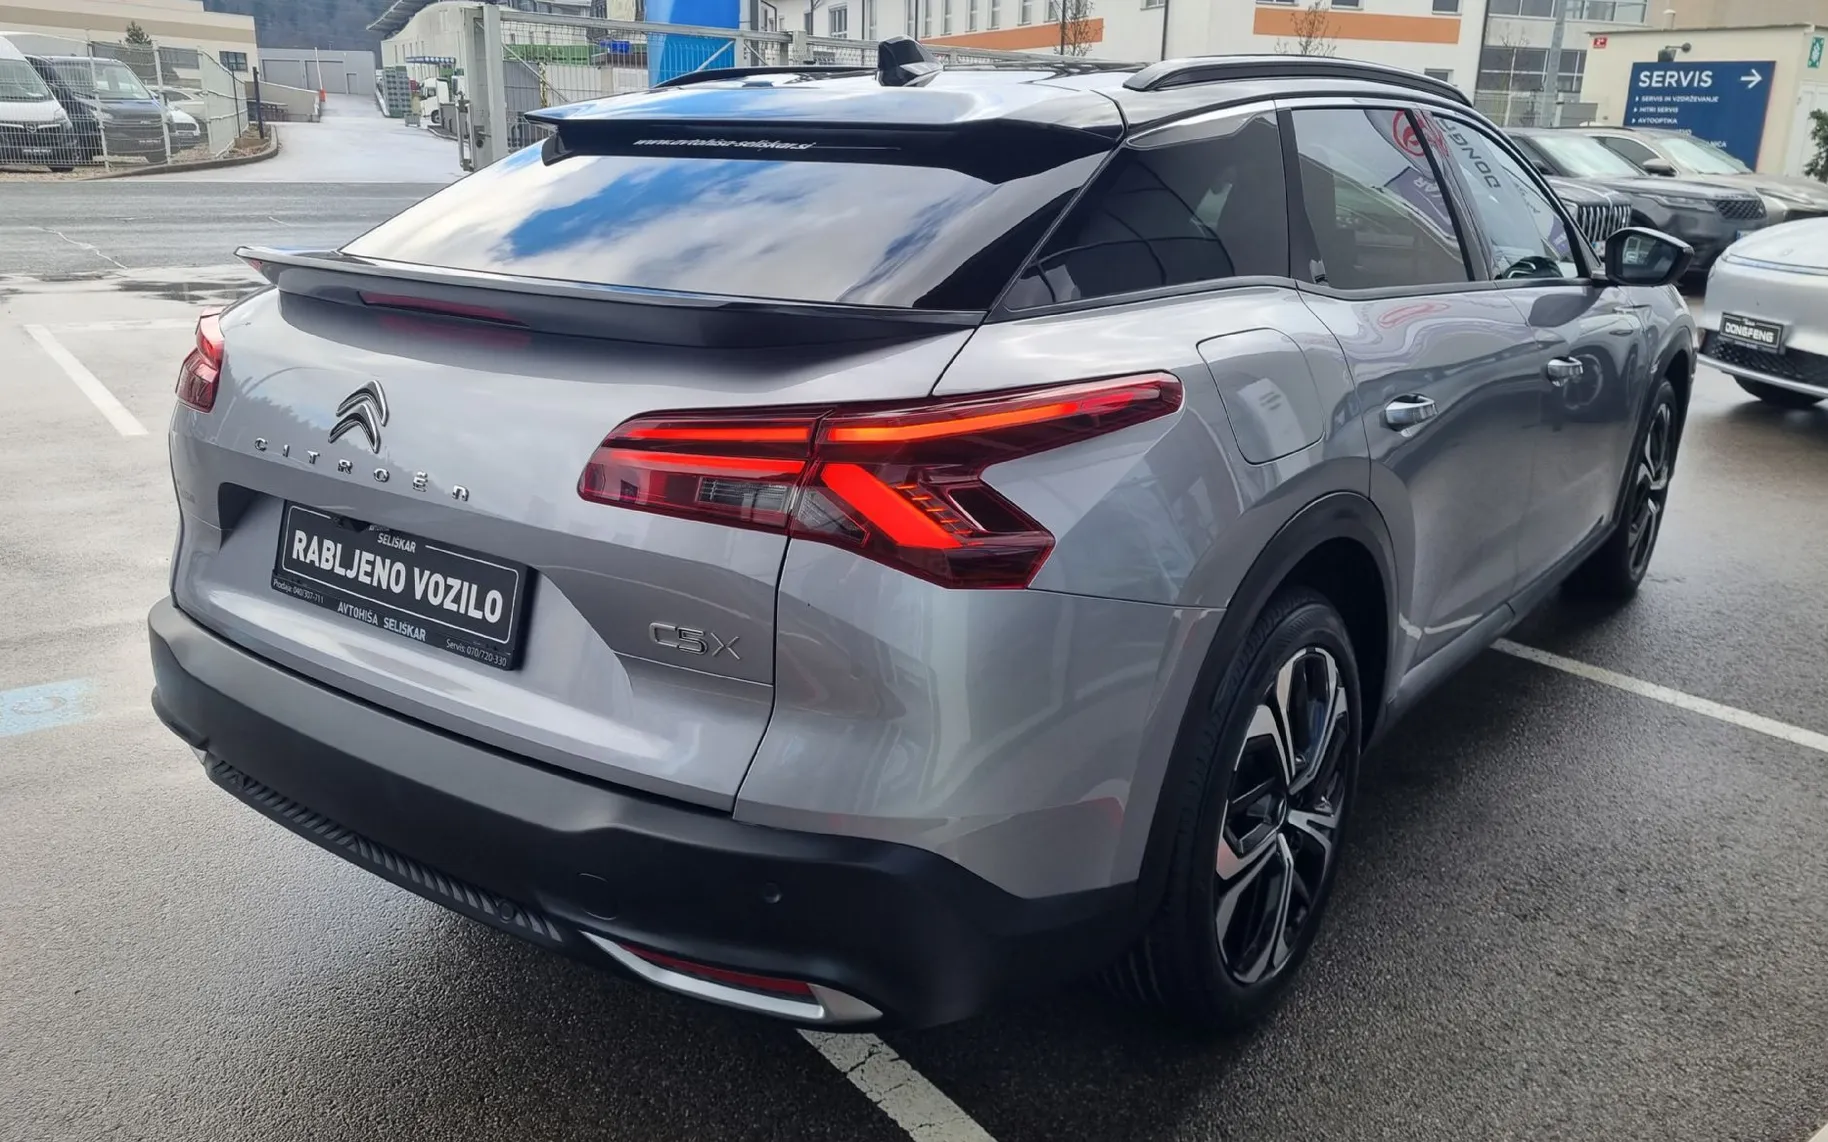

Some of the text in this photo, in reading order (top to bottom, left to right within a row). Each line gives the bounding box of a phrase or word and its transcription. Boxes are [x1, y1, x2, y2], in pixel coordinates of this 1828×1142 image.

[1638, 70, 1713, 88] SERVIS
[1641, 95, 1662, 103] SERVIS
[1663, 95, 1672, 103] IN
[1657, 106, 1679, 114] SERVIS
[1637, 117, 1678, 125] AVTOOPTIKA
[1725, 322, 1775, 343] DONGFENG
[377, 532, 417, 554] SELIŠKAR
[292, 529, 503, 624] RABLJENO VOZILO
[337, 601, 427, 642] AVTOHIŠA SELIŠKAR
